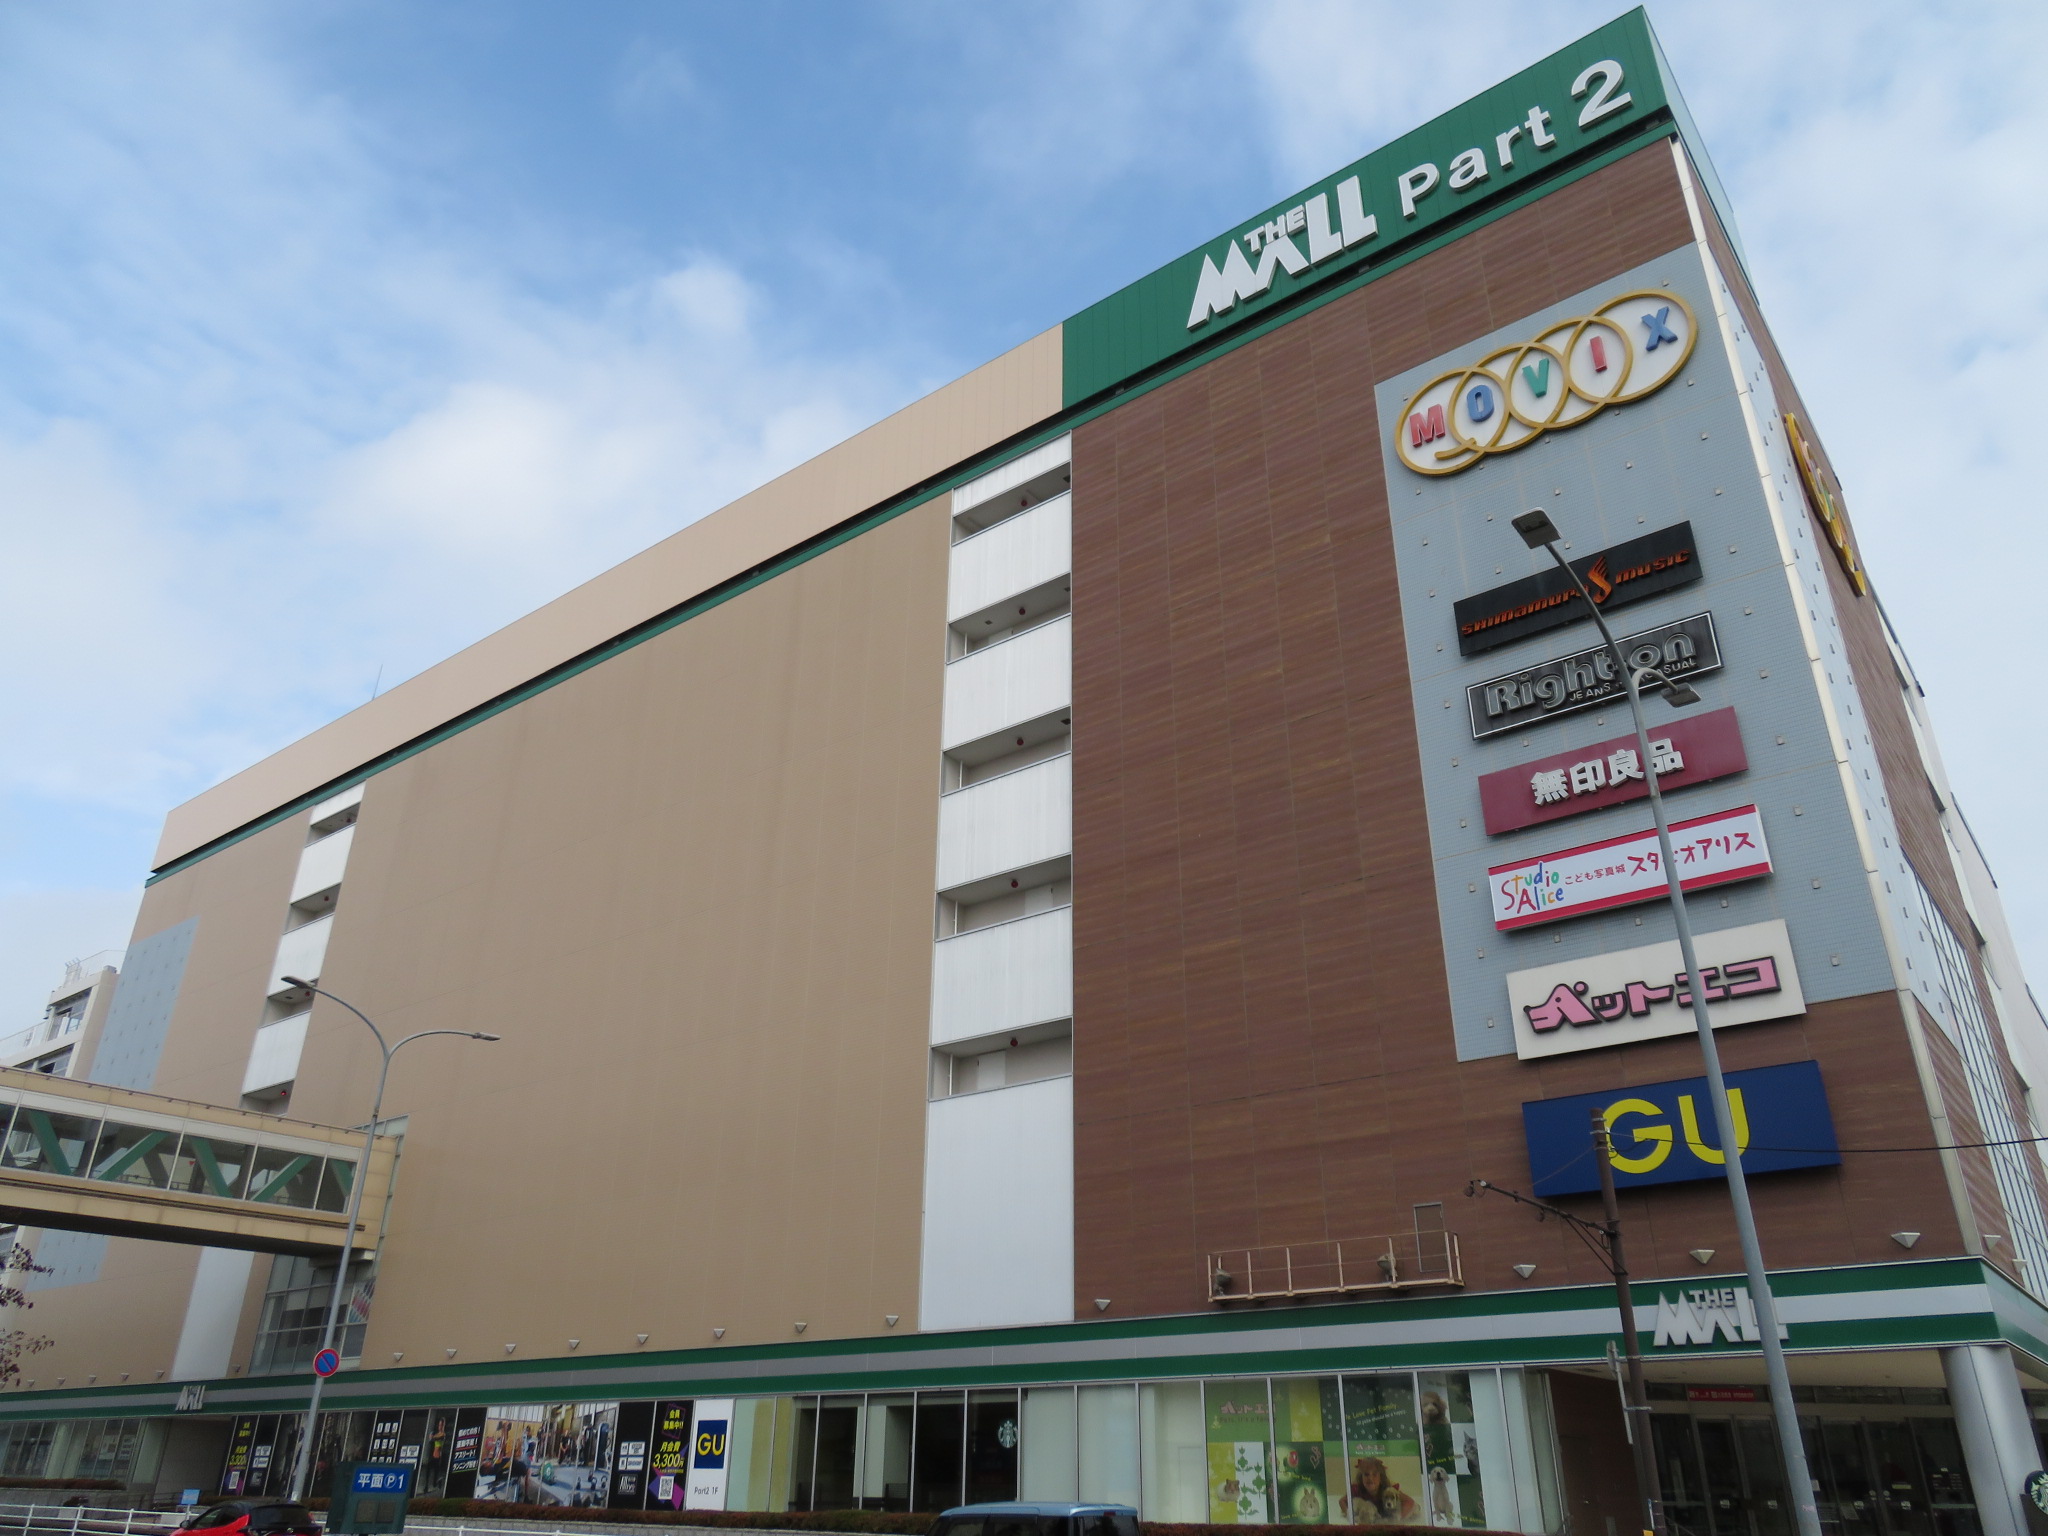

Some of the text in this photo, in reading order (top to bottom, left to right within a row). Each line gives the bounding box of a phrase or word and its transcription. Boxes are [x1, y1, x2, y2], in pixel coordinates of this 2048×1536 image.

[1187, 59, 1632, 331] MALL Part 2
[1244, 205, 1306, 255] THE
[1409, 306, 1679, 449] MOVIX
[1615, 550, 1691, 584] music
[1570, 682, 1611, 701] JEANS
[1530, 738, 1684, 806] 無印良品
[1565, 832, 1756, 885] こども写真城 スタオアリス
[1501, 861, 1560, 911] Studio
[1517, 886, 1565, 914] Alice
[1523, 956, 1781, 1033] ペットエコ
[1602, 1088, 1750, 1174] GU
[1689, 1288, 1735, 1309] THE
[697, 1433, 725, 1456] GU
